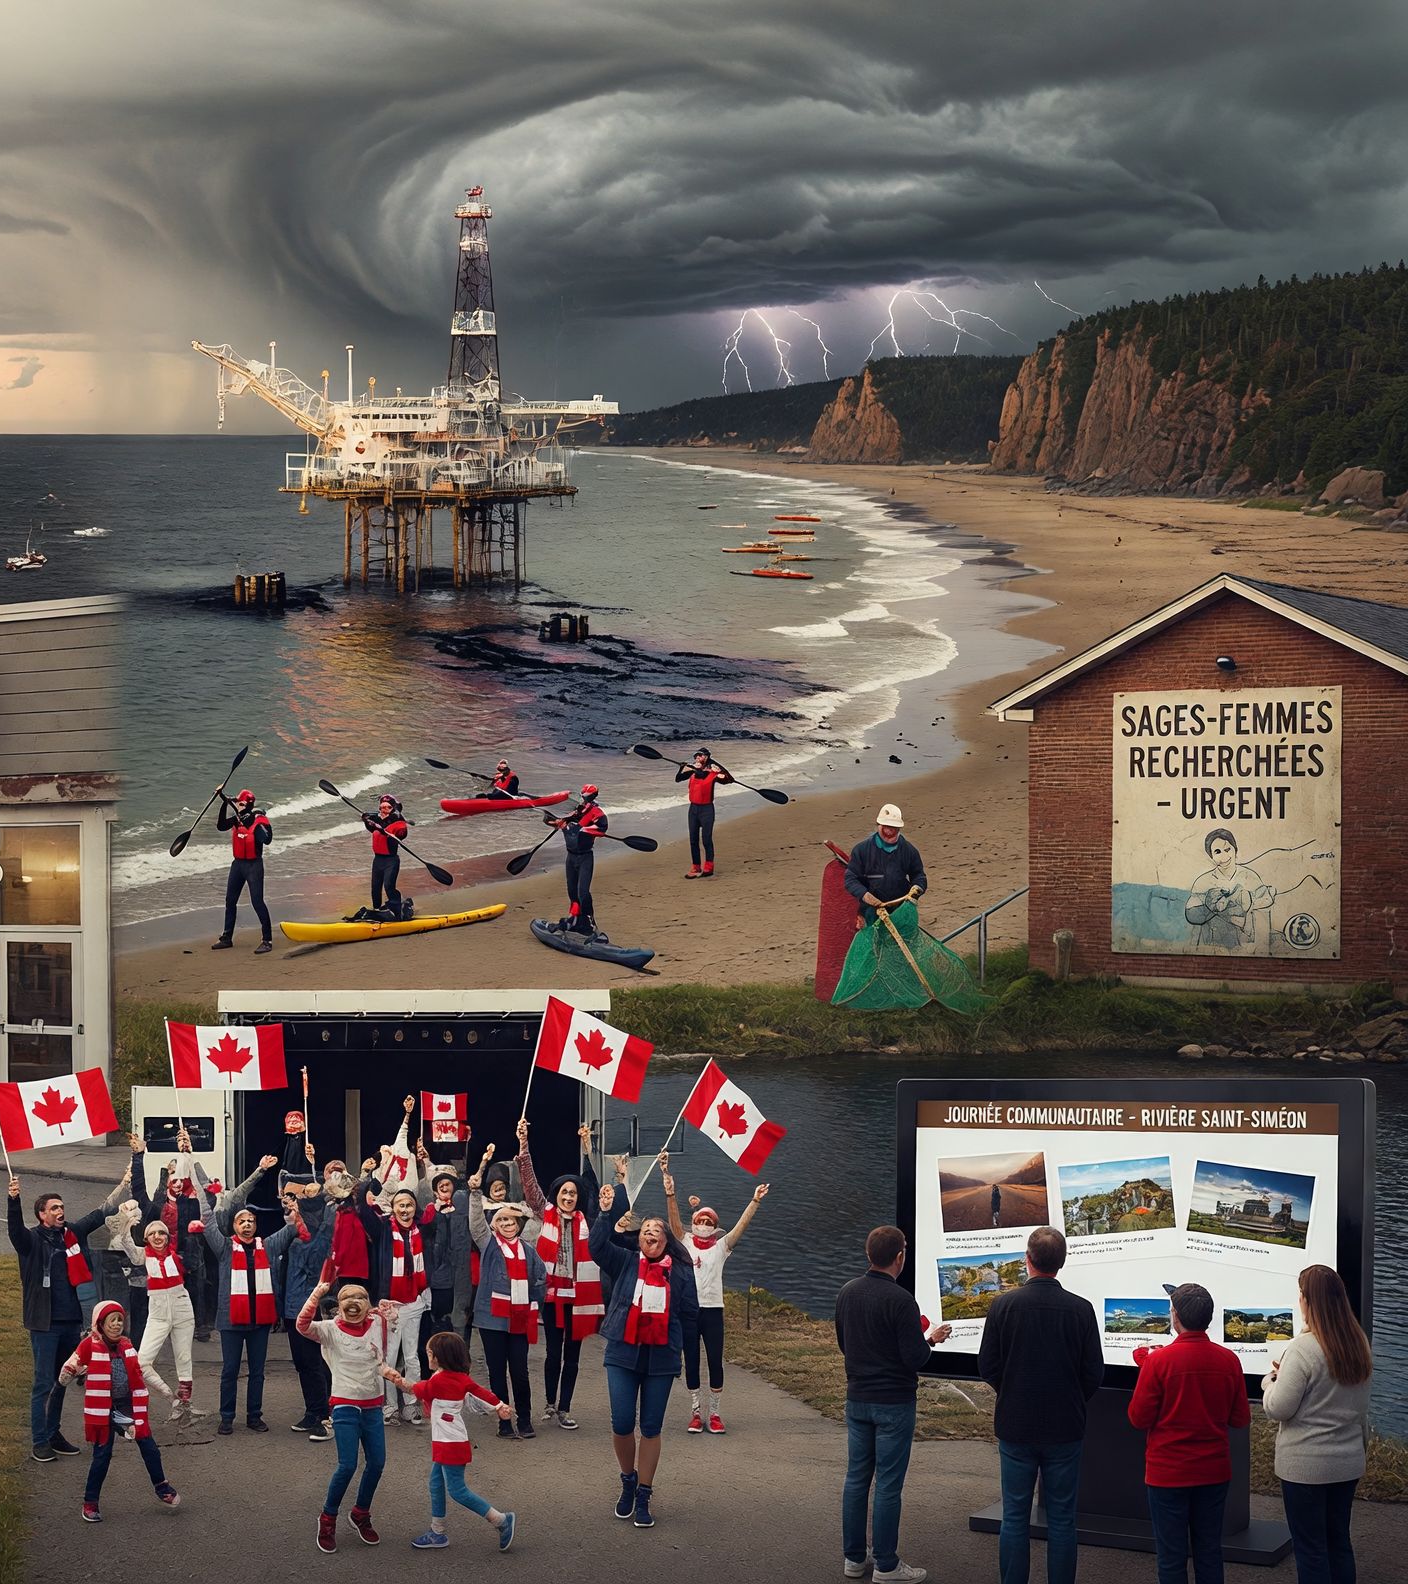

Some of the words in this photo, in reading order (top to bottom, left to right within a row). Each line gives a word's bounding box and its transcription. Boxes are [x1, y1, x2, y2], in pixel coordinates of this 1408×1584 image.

[1121, 700, 1333, 737] SAGES-FEMMES
[1128, 737, 1325, 778] RECHERCHÉES
[1181, 786, 1291, 820] URGENT
[1006, 1106, 1124, 1126] COMMUNAUTAIRE
[1141, 1105, 1197, 1127] RIVIÈRE
[1201, 1106, 1308, 1129] SAINT-SIMÉON
